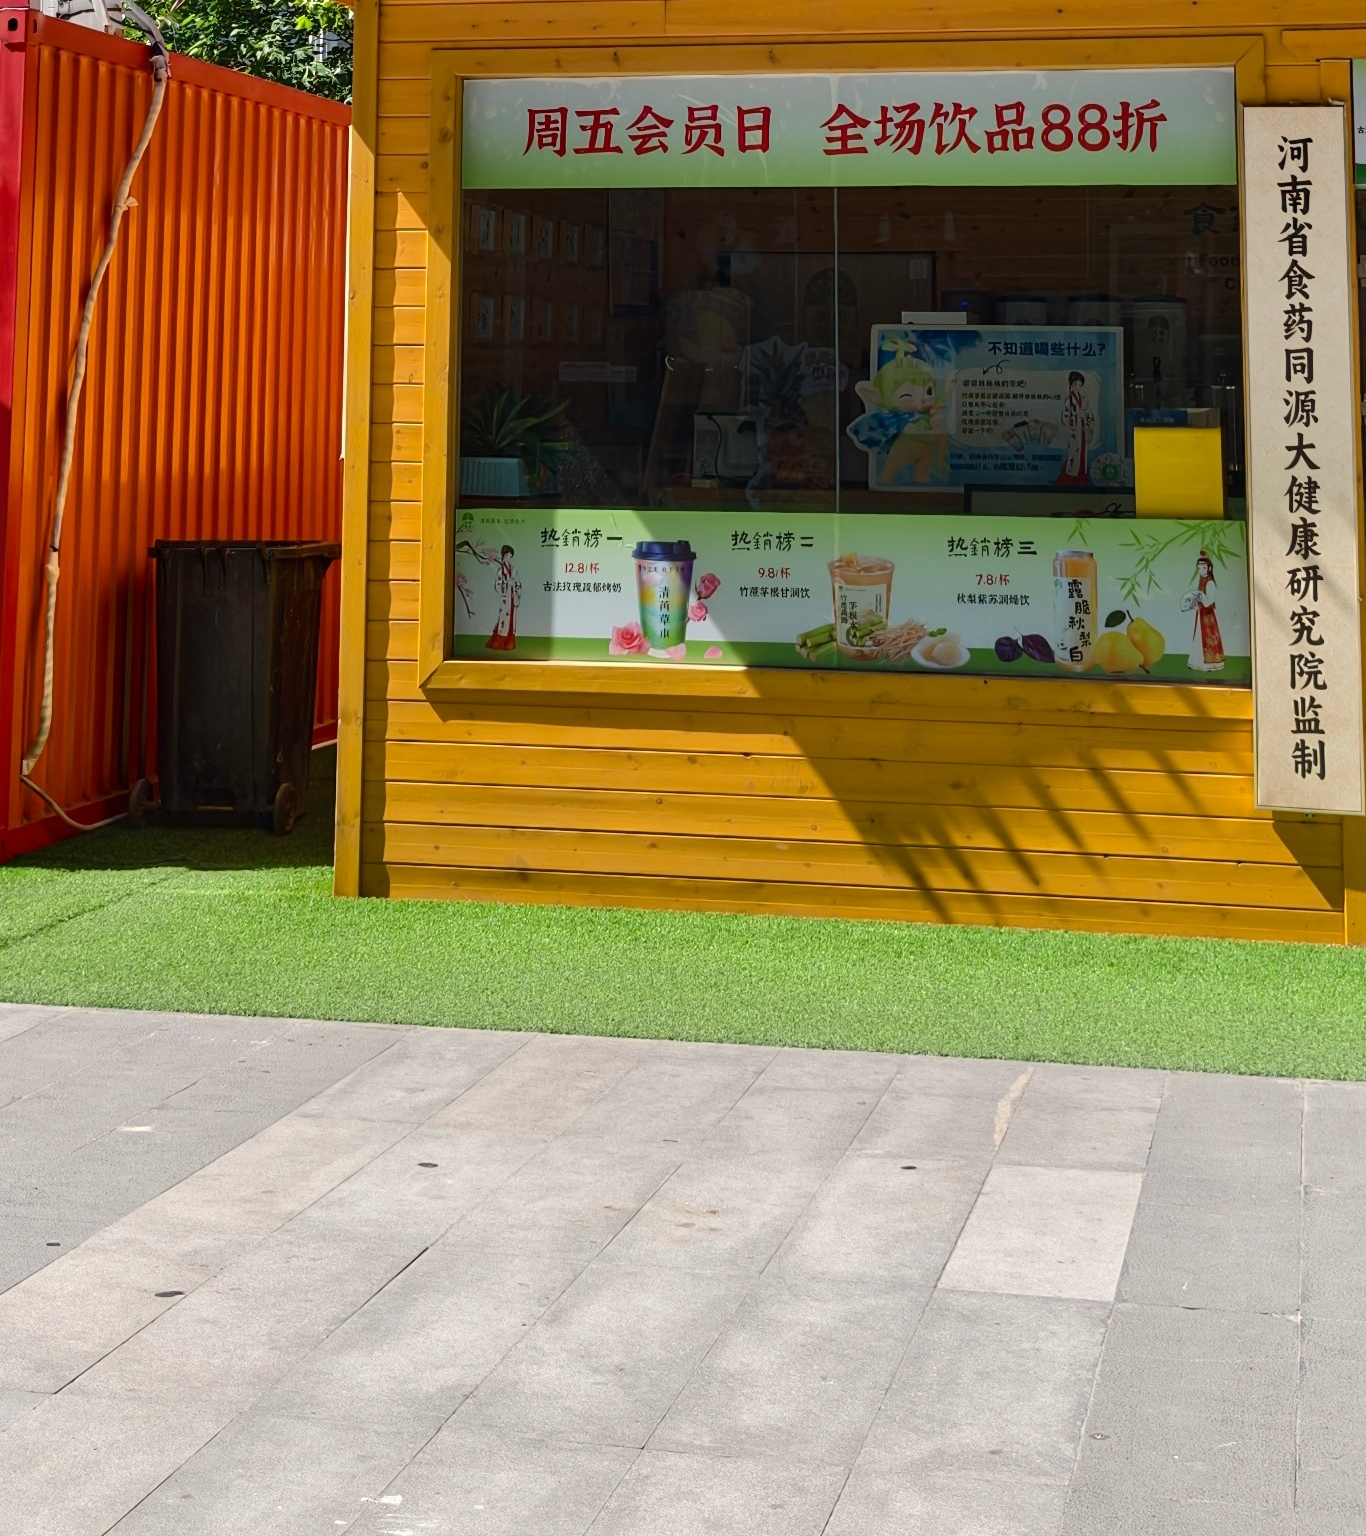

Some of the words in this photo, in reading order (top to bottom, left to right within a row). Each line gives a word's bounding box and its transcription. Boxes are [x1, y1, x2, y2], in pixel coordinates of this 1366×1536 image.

[522, 104, 773, 157] 周五会员日
[821, 98, 1168, 155] 全场饮品88折
[987, 341, 1107, 357] 不知道喝些什么?
[1277, 135, 1328, 781] 河南省食药同源大健康研究院监制
[565, 562, 600, 574] 12.8/杯
[758, 567, 791, 579] 9.8/杯
[975, 573, 1010, 586] 7.8/杯
